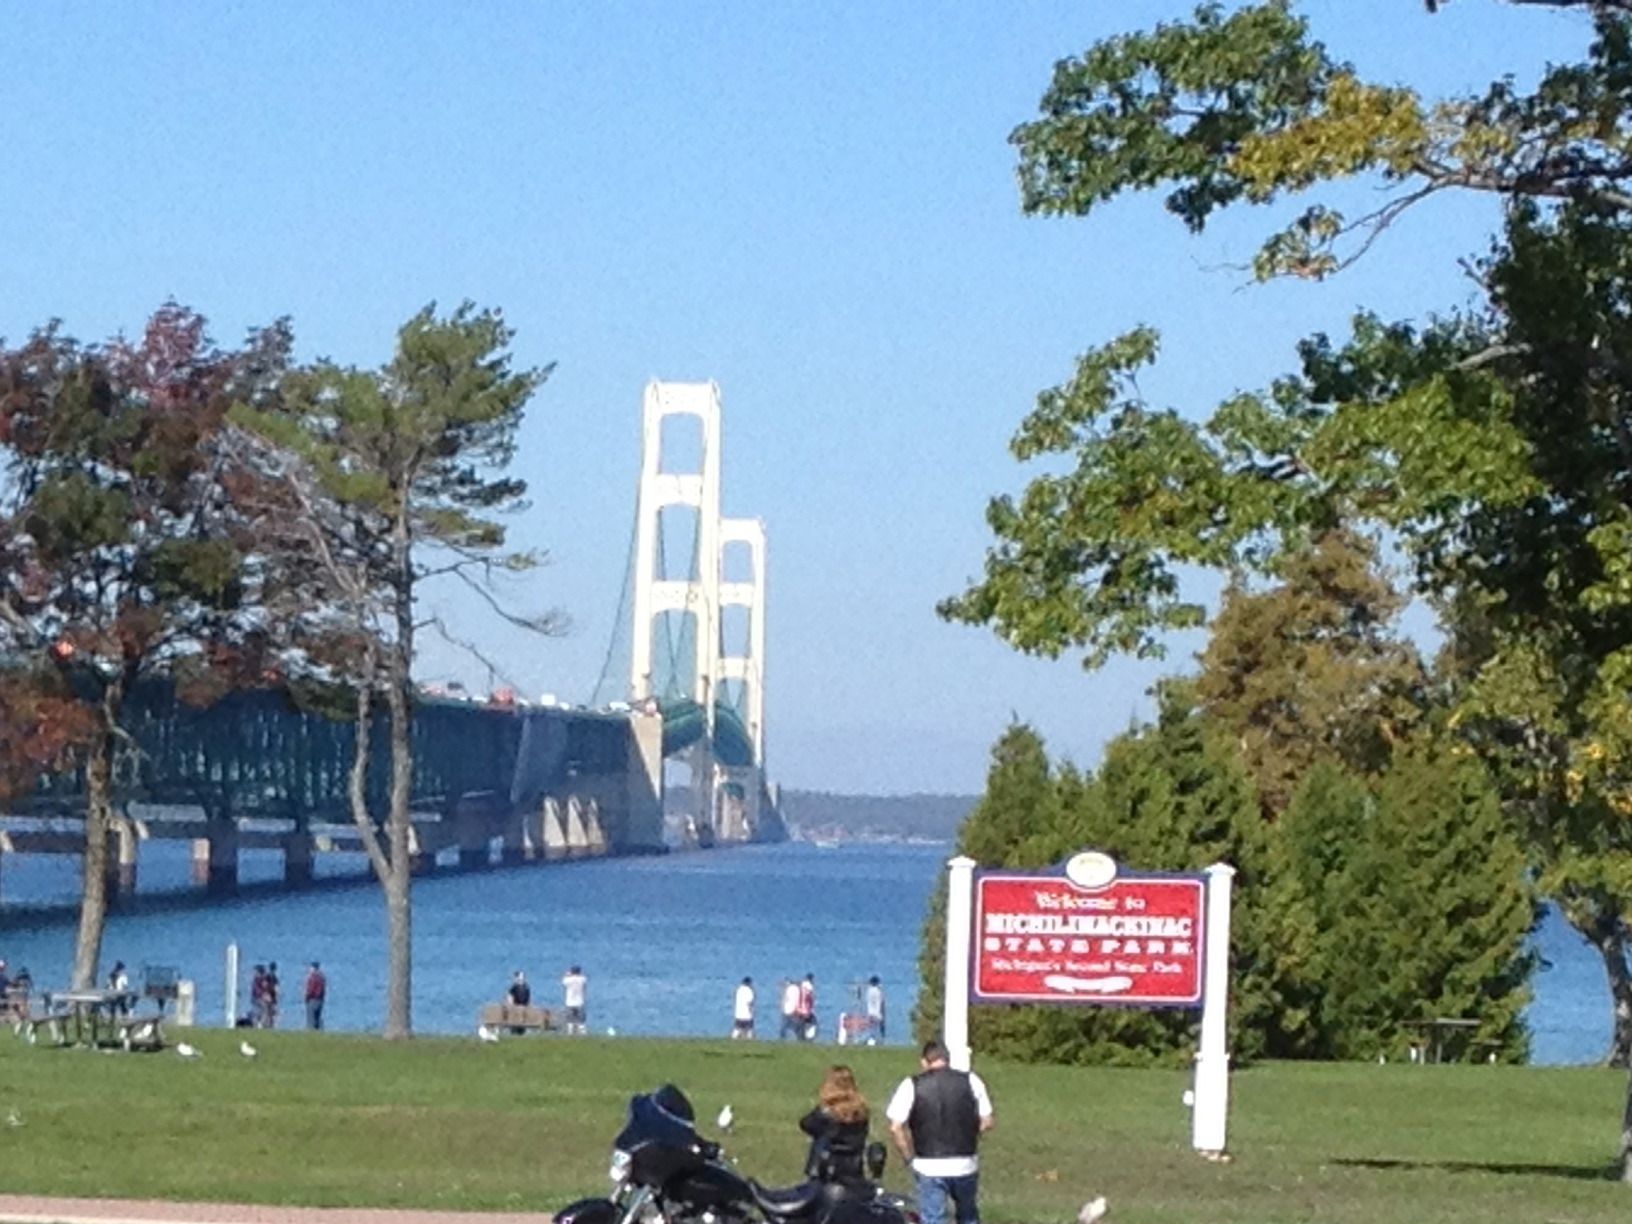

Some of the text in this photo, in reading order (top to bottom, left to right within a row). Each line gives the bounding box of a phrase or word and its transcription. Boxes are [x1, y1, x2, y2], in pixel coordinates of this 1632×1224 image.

[1034, 890, 1146, 910] Welcome to
[983, 937, 1194, 955] STATE PARK
